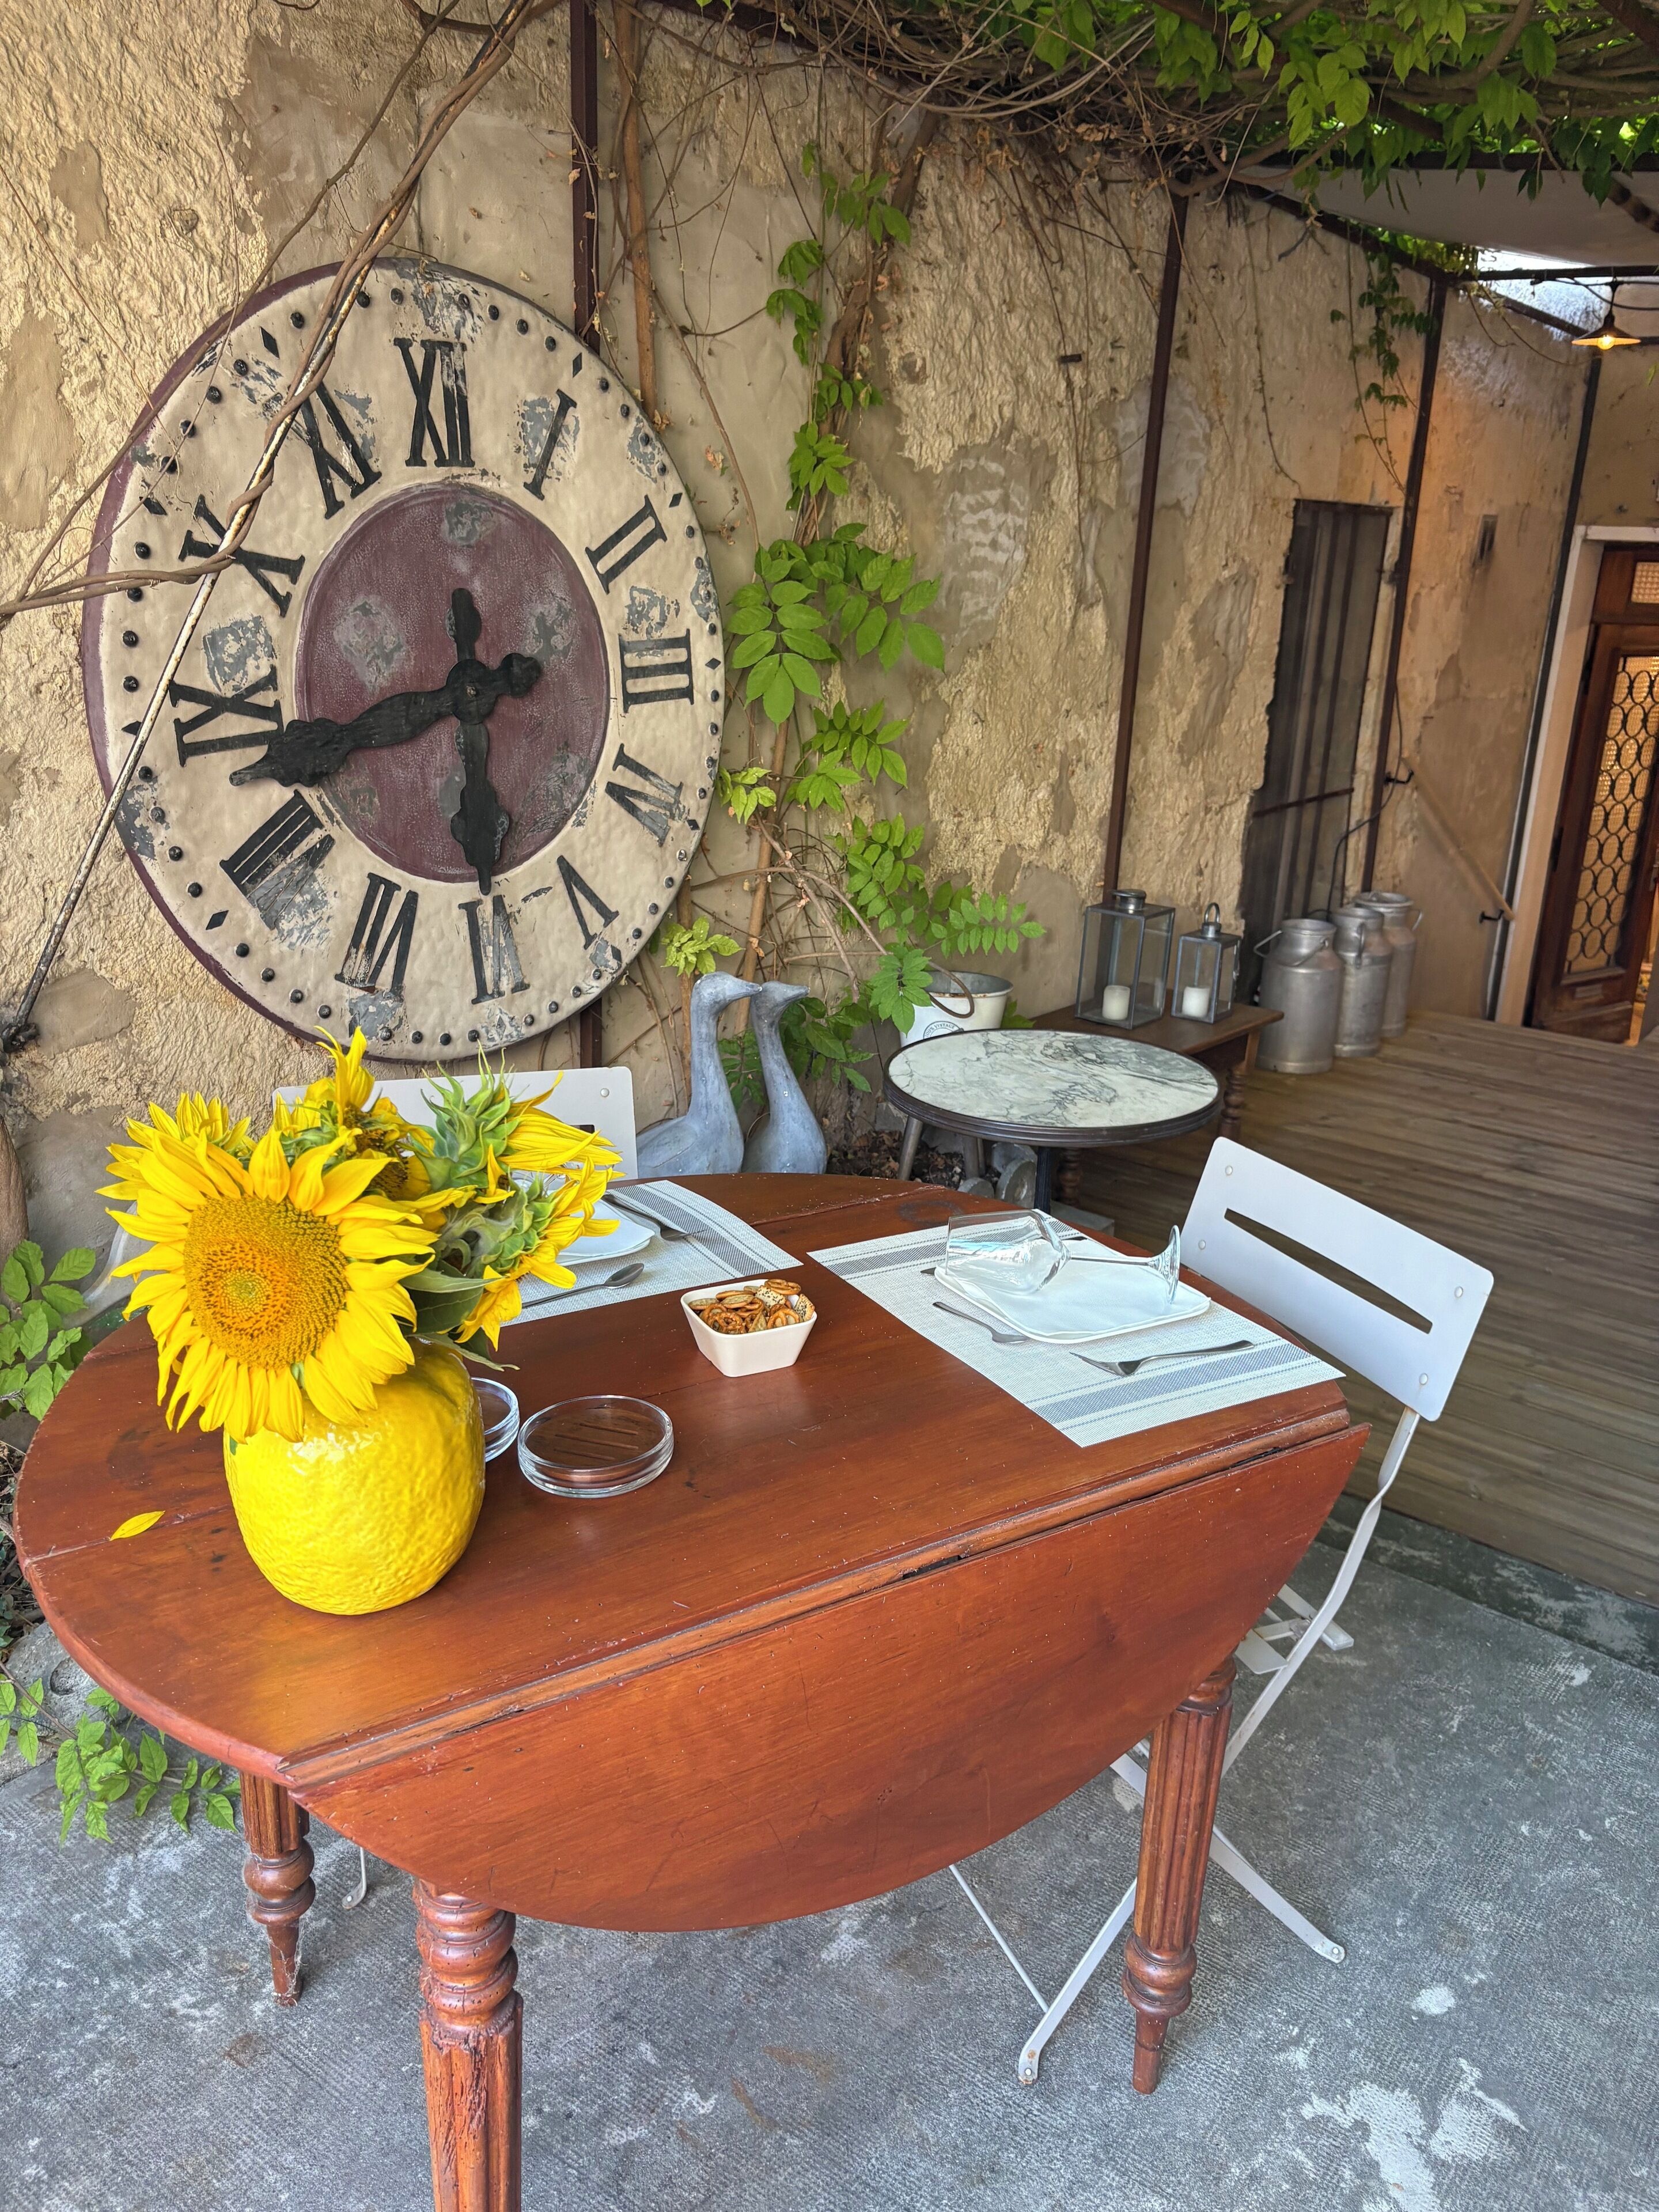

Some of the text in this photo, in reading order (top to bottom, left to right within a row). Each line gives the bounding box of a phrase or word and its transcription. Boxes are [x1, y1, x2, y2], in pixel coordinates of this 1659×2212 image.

[263, 377, 382, 520] XI
[393, 338, 475, 467] XII
[523, 389, 577, 501] I
[178, 494, 306, 619] X
[585, 494, 668, 595] II
[169, 664, 285, 767] IX
[618, 628, 695, 713] III
[556, 855, 619, 950] V
